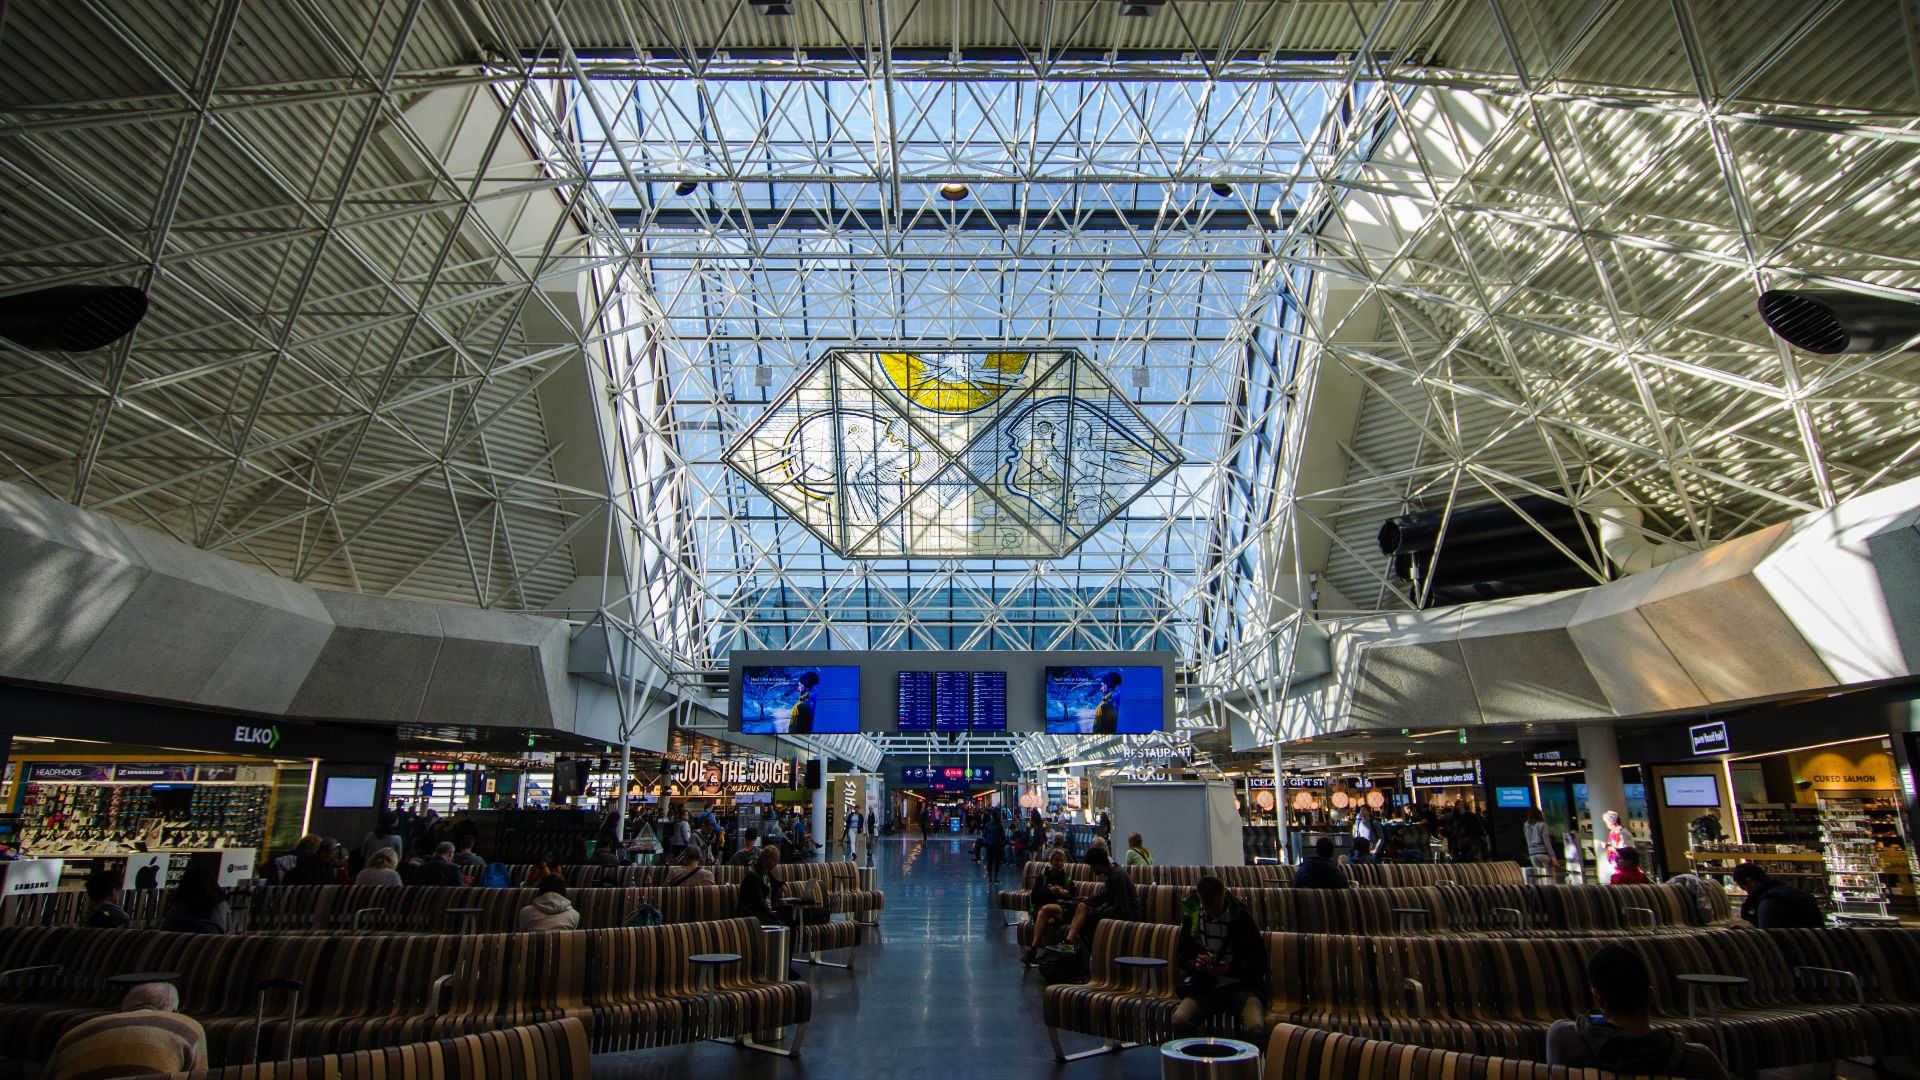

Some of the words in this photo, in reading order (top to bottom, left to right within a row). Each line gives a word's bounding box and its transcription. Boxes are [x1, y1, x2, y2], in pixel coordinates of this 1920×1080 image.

[234, 726, 272, 744] ELKO
[1704, 732, 1715, 743] food
[1123, 747, 1192, 758] RESTAURANT
[36, 768, 82, 776] HEADPHONES
[680, 760, 708, 783] JOE
[720, 761, 747, 783] THE
[750, 762, 790, 784] JUICE
[1290, 779, 1312, 787] GIFT
[1814, 775, 1841, 783] CURED
[1843, 775, 1876, 783] SALMON
[14, 881, 50, 891] SAMSUNG
